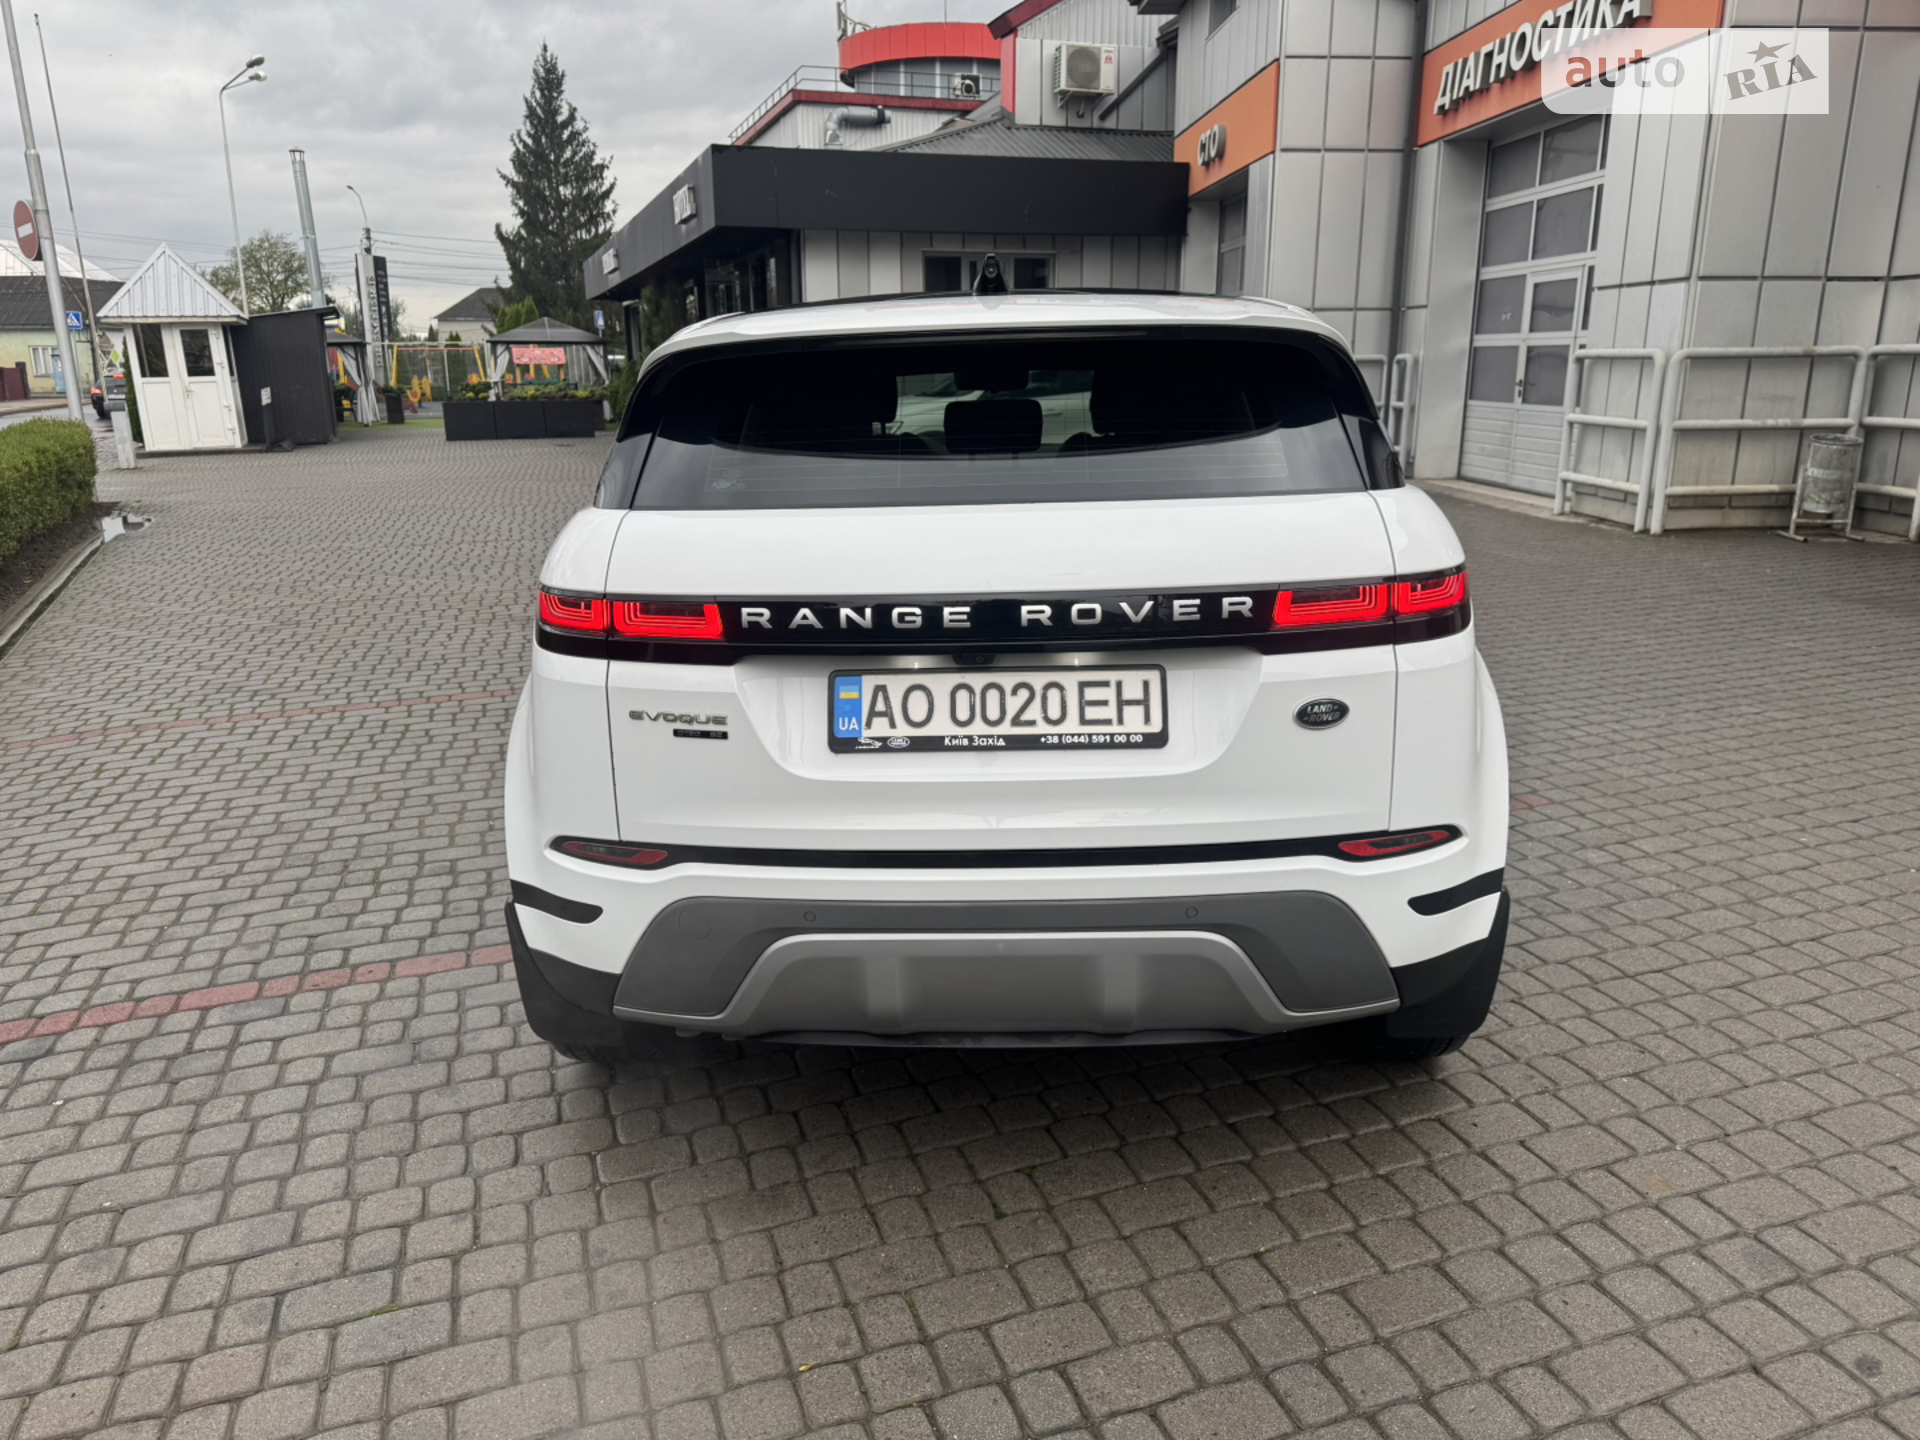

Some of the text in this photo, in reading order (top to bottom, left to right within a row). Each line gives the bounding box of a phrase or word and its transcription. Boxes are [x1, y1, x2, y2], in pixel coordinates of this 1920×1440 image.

[1197, 124, 1221, 166] СТО
[741, 596, 1253, 629] RANGE ROVER
[865, 679, 1151, 730] AO 0020 EH
[1307, 703, 1333, 714] LAND
[628, 709, 728, 726] EVOQUE
[1309, 711, 1341, 722] ROVER
[839, 717, 859, 731] UA
[944, 734, 1006, 746] Київ Захід
[1040, 732, 1143, 745] +38 (044) 591 00 00
